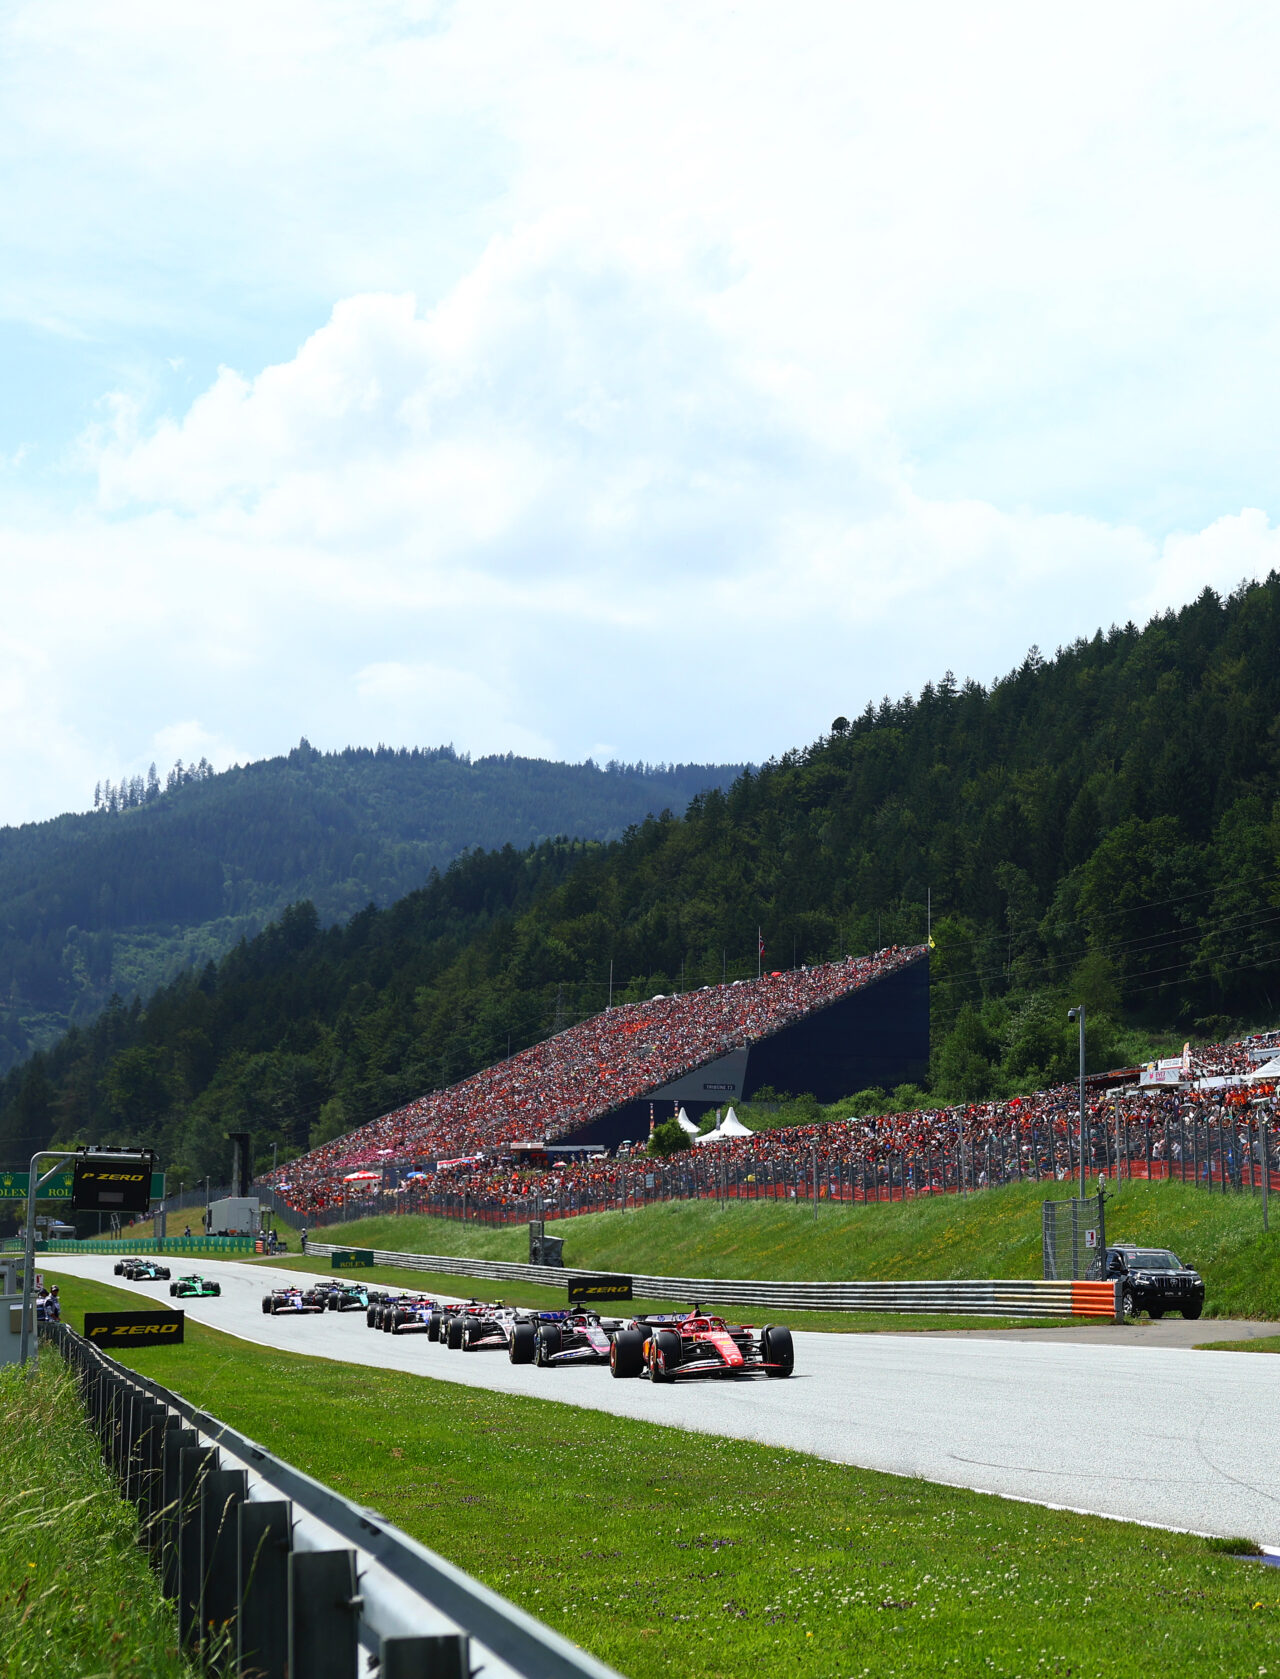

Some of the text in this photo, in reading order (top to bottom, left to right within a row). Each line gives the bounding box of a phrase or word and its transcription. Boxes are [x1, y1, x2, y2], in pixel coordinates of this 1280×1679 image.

[96, 1173, 145, 1181] ZERO
[48, 1188, 72, 1197] ROL
[585, 1286, 629, 1294] ZERO
[90, 1324, 180, 1336] P ZERO
